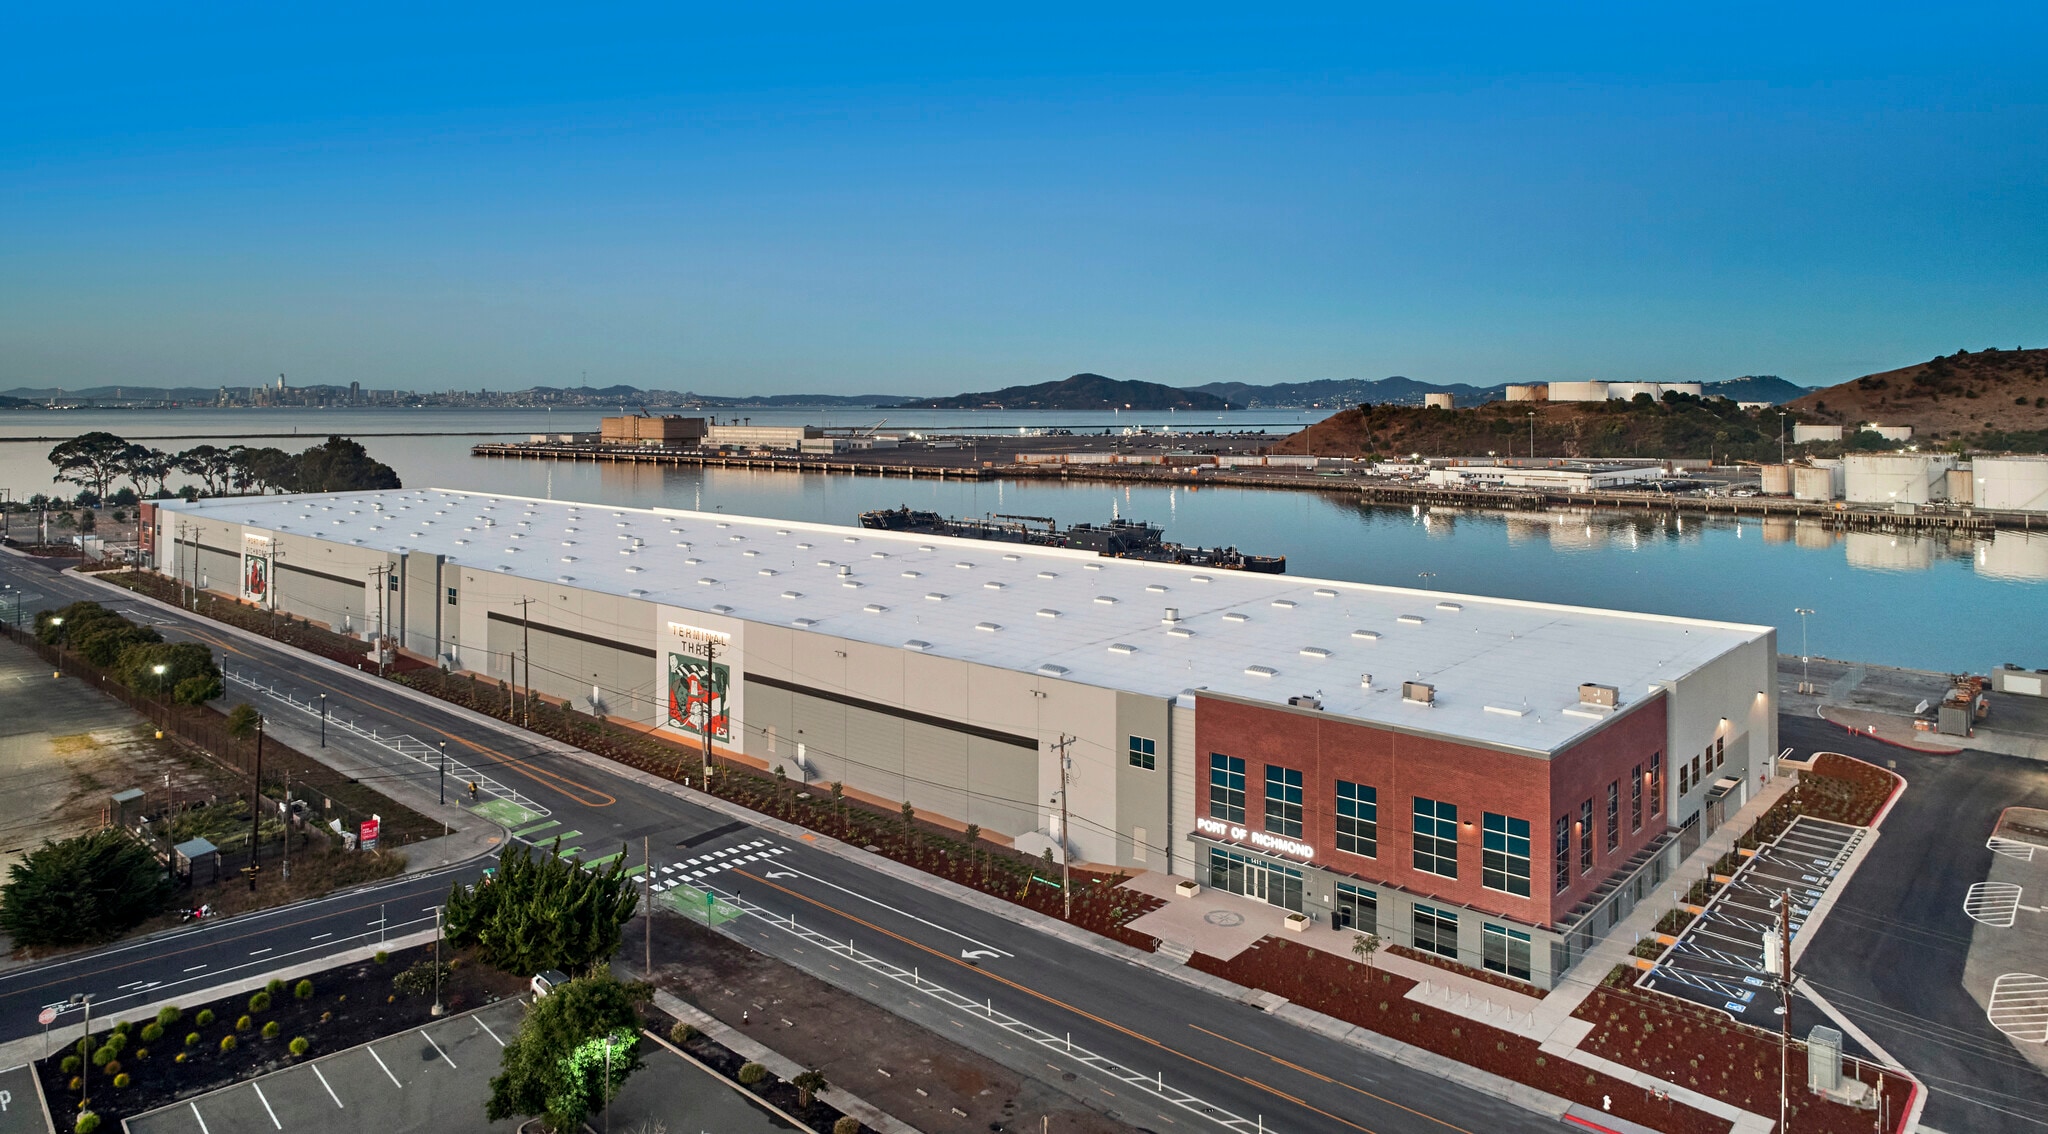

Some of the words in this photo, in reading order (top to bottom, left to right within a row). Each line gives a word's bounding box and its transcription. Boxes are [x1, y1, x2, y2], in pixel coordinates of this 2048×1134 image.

[672, 625, 726, 647] TERMINAL
[681, 641, 716, 659] THREE
[1197, 818, 1228, 835] PORT
[1231, 826, 1248, 840] OF
[1251, 832, 1314, 858] RICHMOND
[1251, 858, 1262, 866] 1411
